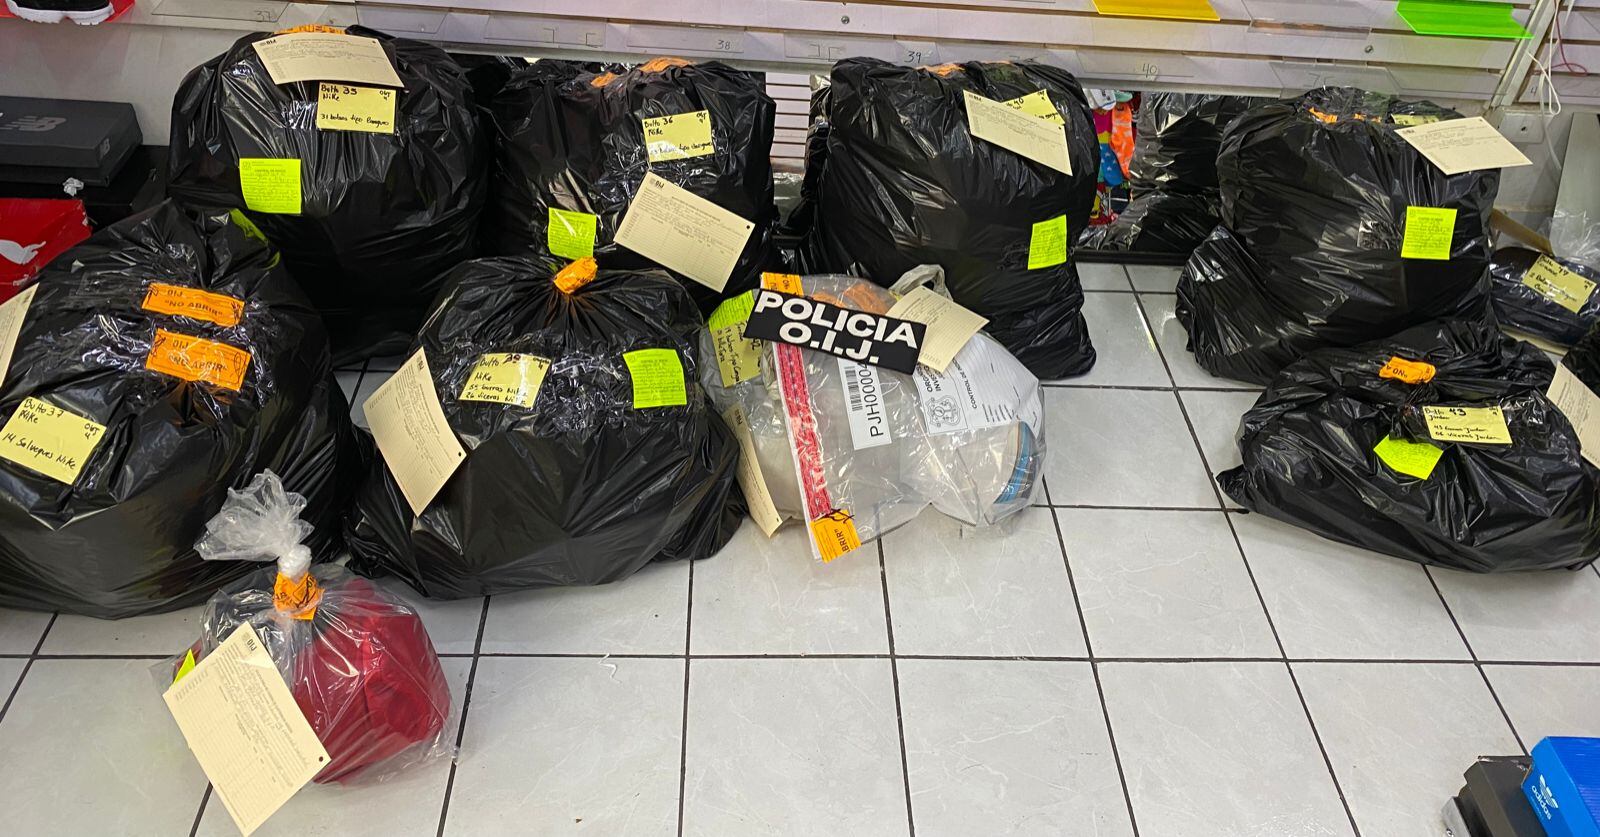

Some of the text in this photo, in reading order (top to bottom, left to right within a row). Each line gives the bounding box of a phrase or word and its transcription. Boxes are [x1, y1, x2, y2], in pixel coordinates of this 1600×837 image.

[256, 10, 271, 23] 37
[717, 39, 730, 50] 38
[904, 50, 922, 64] 39
[1142, 63, 1158, 79] 40
[321, 92, 340, 102] Nike
[662, 116, 674, 126] 36
[167, 289, 183, 298] OIJ
[753, 290, 919, 350] POLICIA
[172, 340, 189, 350] OIJ
[779, 321, 880, 365] O.I.J.
[473, 371, 492, 381] Nike
[47, 407, 65, 418] 37
[1449, 407, 1467, 417] 43
[3, 432, 17, 443] 14
[55, 454, 77, 470] Nike
[246, 638, 258, 651] OIJ
[1531, 785, 1552, 820] adidas
